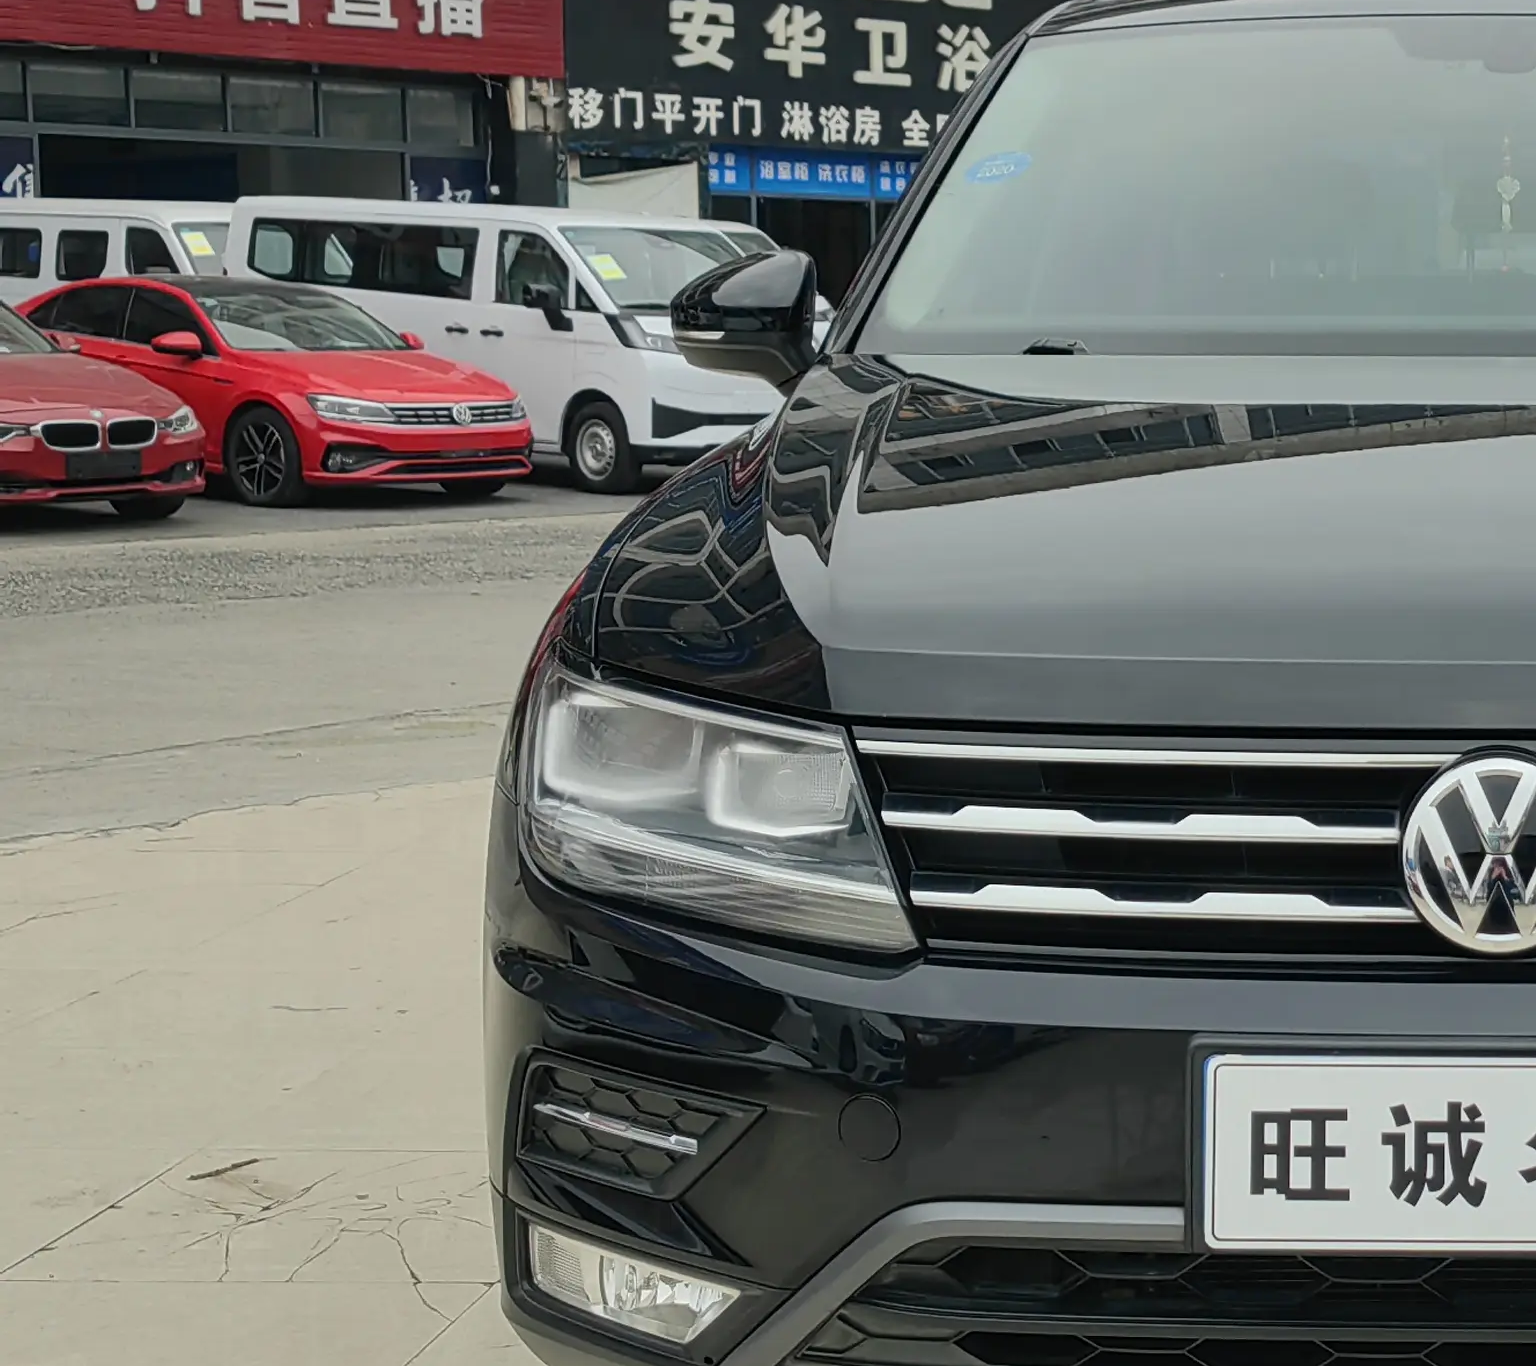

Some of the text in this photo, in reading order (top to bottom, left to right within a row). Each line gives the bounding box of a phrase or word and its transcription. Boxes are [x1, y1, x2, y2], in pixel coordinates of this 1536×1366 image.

[567, 87, 762, 138] 移门平开门
[780, 100, 882, 147] 淋浴房
